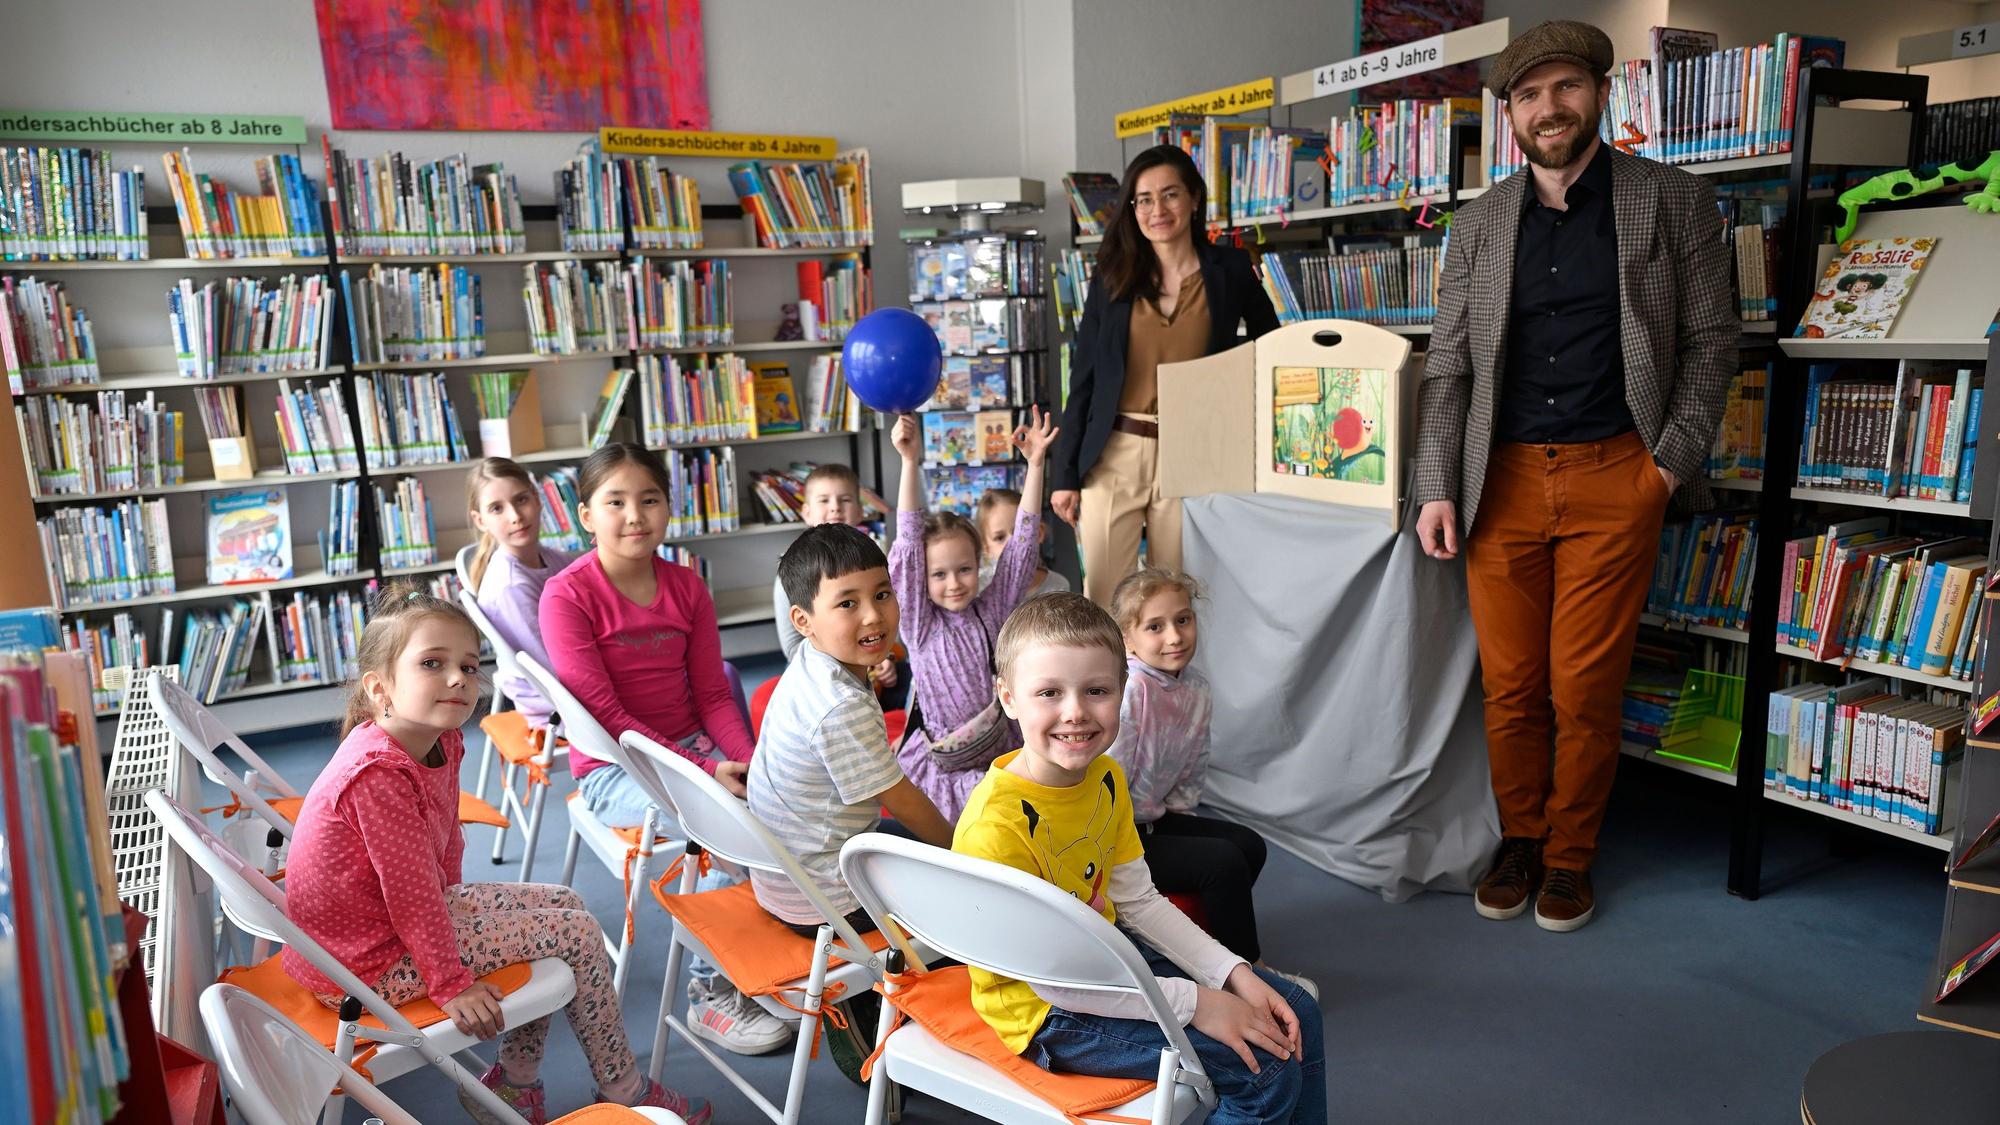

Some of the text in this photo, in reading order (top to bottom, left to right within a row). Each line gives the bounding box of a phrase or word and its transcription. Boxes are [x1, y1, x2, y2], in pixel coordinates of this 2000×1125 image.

[1960, 28, 1986, 47] 5.1
[1318, 68, 1335, 85] 4.1
[1341, 65, 1357, 82] ab
[1361, 61, 1369, 77] 6
[1396, 48, 1437, 69] Jahre
[1212, 96, 1225, 111] ab
[1229, 93, 1236, 106] 4
[1239, 87, 1273, 105] Jahre
[0, 115, 283, 136] ndersachbücher ab 8 Jahre
[606, 132, 822, 155] Kindersachbücher ab 4 Jahre
